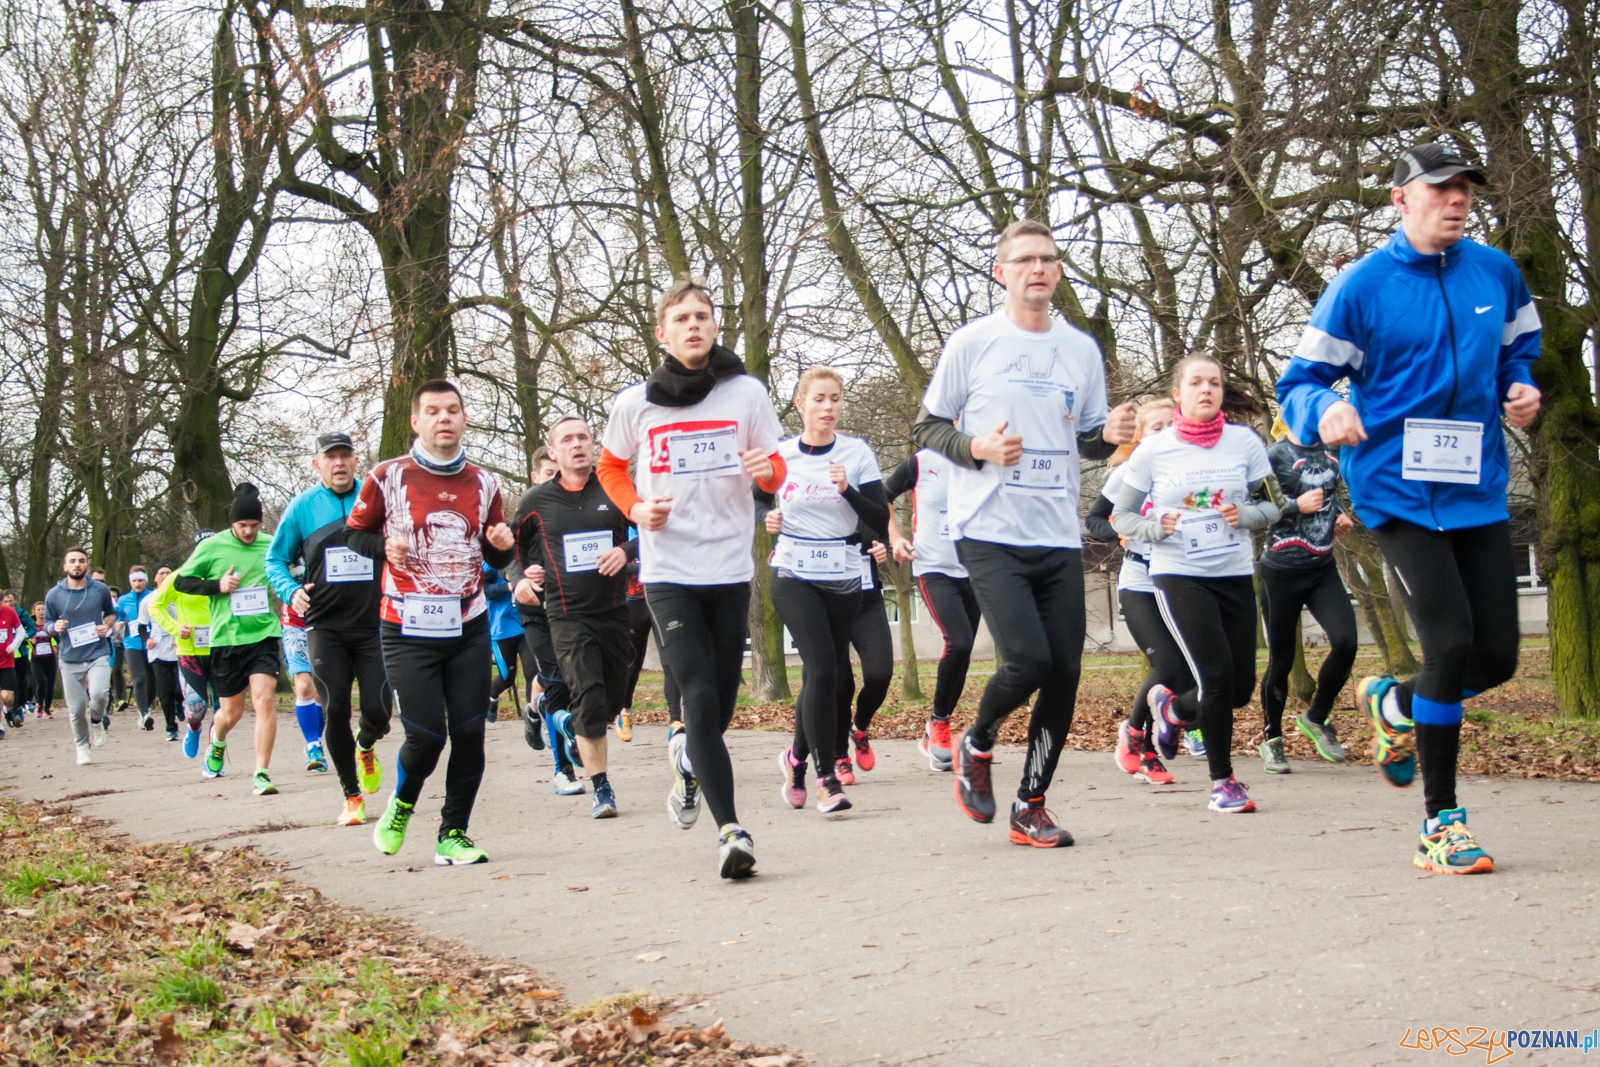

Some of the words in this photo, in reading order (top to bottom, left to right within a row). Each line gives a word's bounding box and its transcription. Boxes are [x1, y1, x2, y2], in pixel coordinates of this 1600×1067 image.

[1433, 434, 1458, 449] 372
[693, 441, 716, 454] 274
[1030, 459, 1052, 470] 180
[1205, 523, 1218, 533] 89
[582, 542, 598, 551] 699
[810, 550, 828, 559] 146
[423, 605, 443, 614] 824
